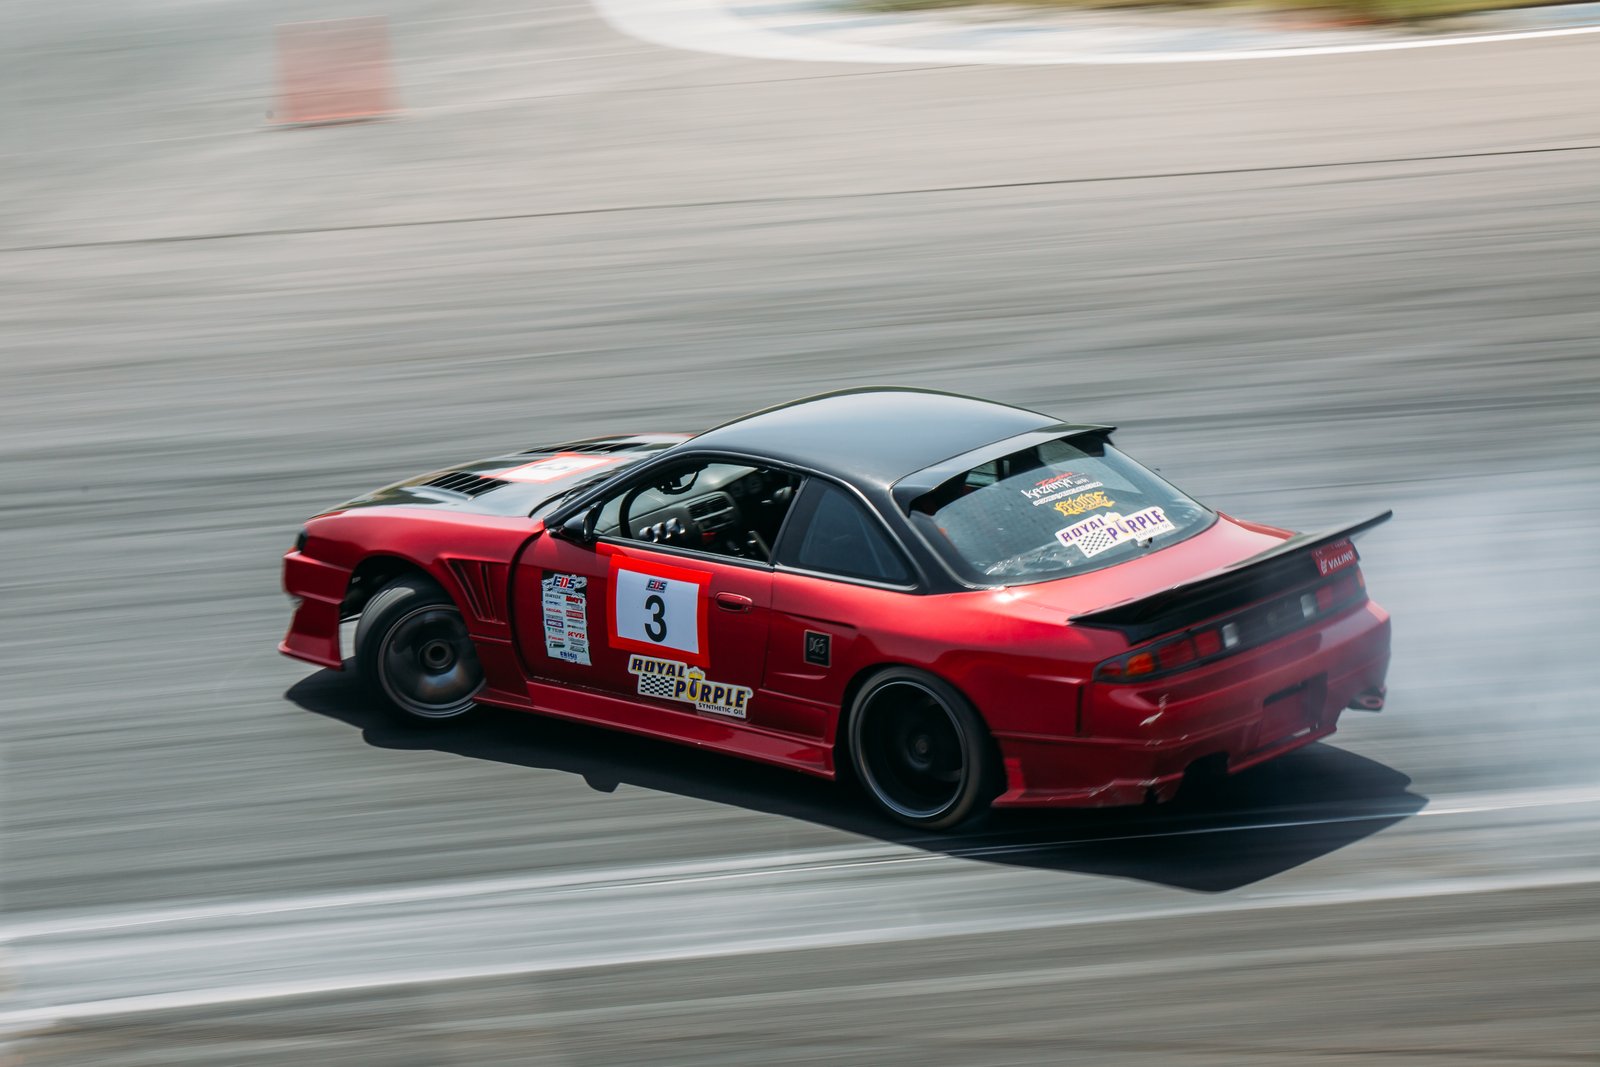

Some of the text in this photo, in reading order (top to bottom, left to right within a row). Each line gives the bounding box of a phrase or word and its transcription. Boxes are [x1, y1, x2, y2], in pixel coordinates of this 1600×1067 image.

[1061, 517, 1105, 542] ROYAL
[1106, 510, 1165, 541] PURPLE
[552, 576, 576, 589] EDS
[647, 579, 667, 590] EDS
[644, 594, 668, 643] 3
[631, 658, 686, 678] ROYAL
[674, 678, 747, 708] PURPLE
[698, 702, 744, 716] SYNTHETIC OIL
